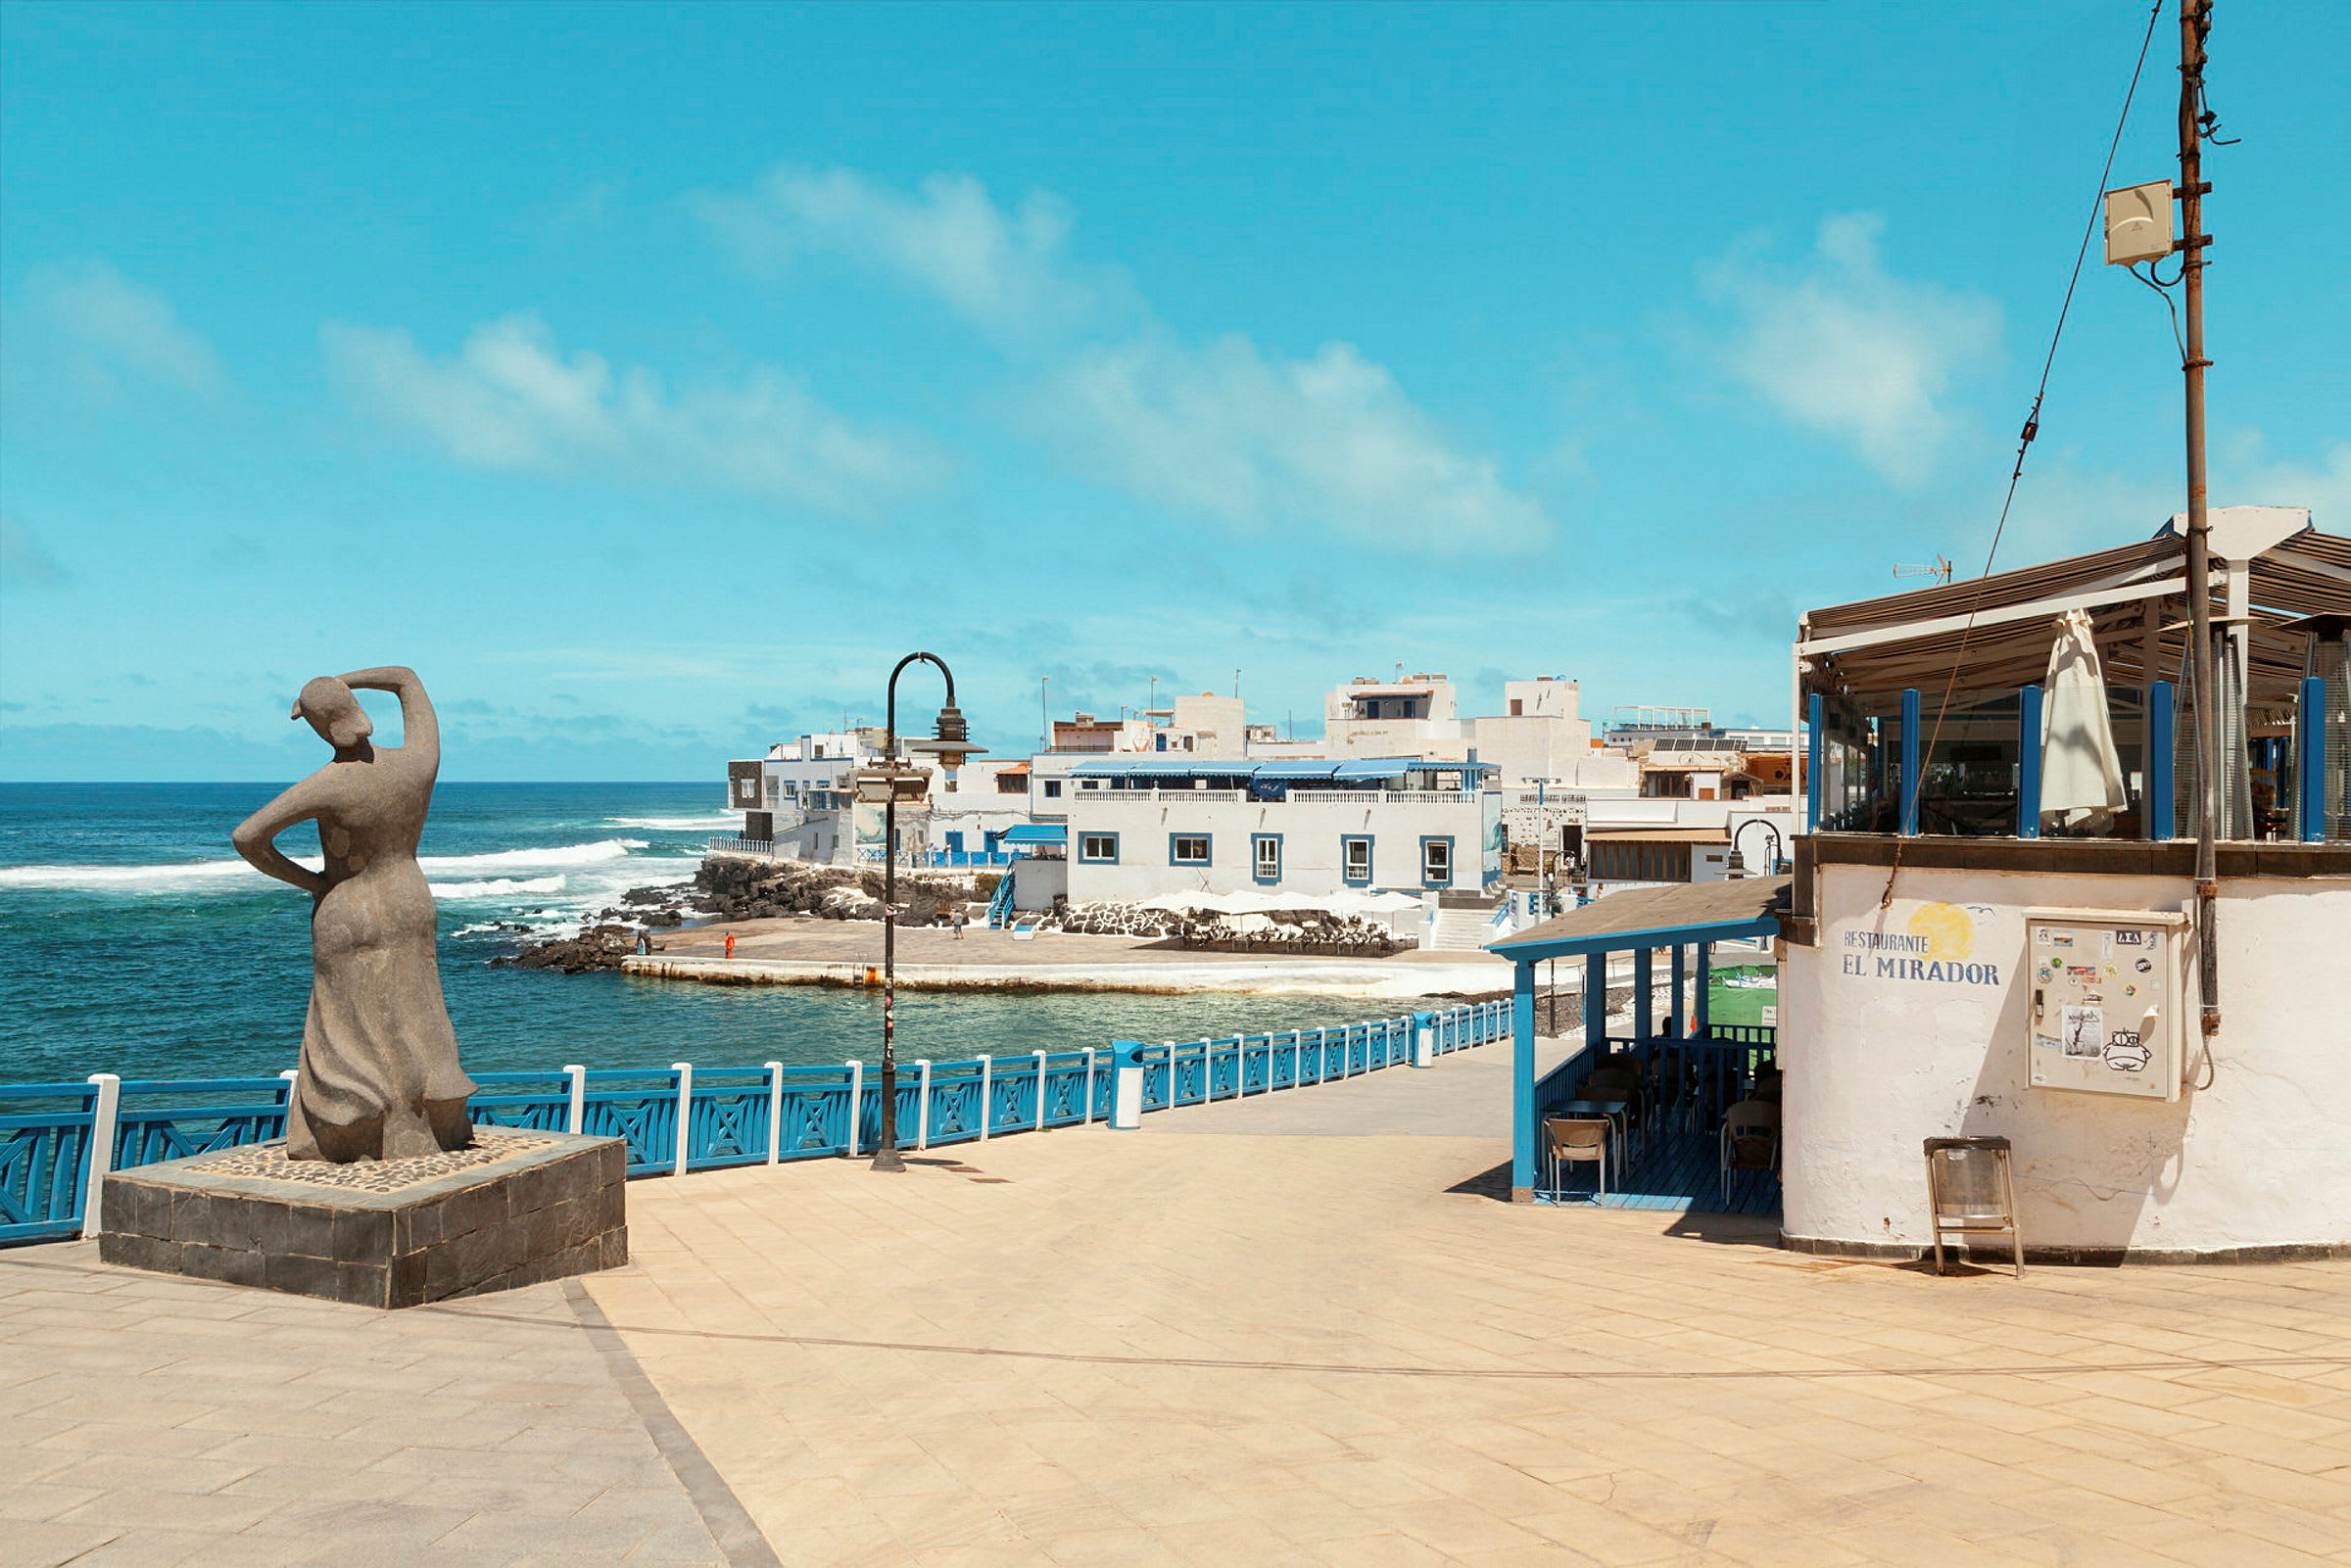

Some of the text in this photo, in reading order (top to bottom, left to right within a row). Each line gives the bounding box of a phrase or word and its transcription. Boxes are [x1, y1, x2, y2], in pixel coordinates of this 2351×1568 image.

[1844, 930, 1929, 954] RESTAURANTE
[1843, 954, 2000, 986] EL MIRADOR
